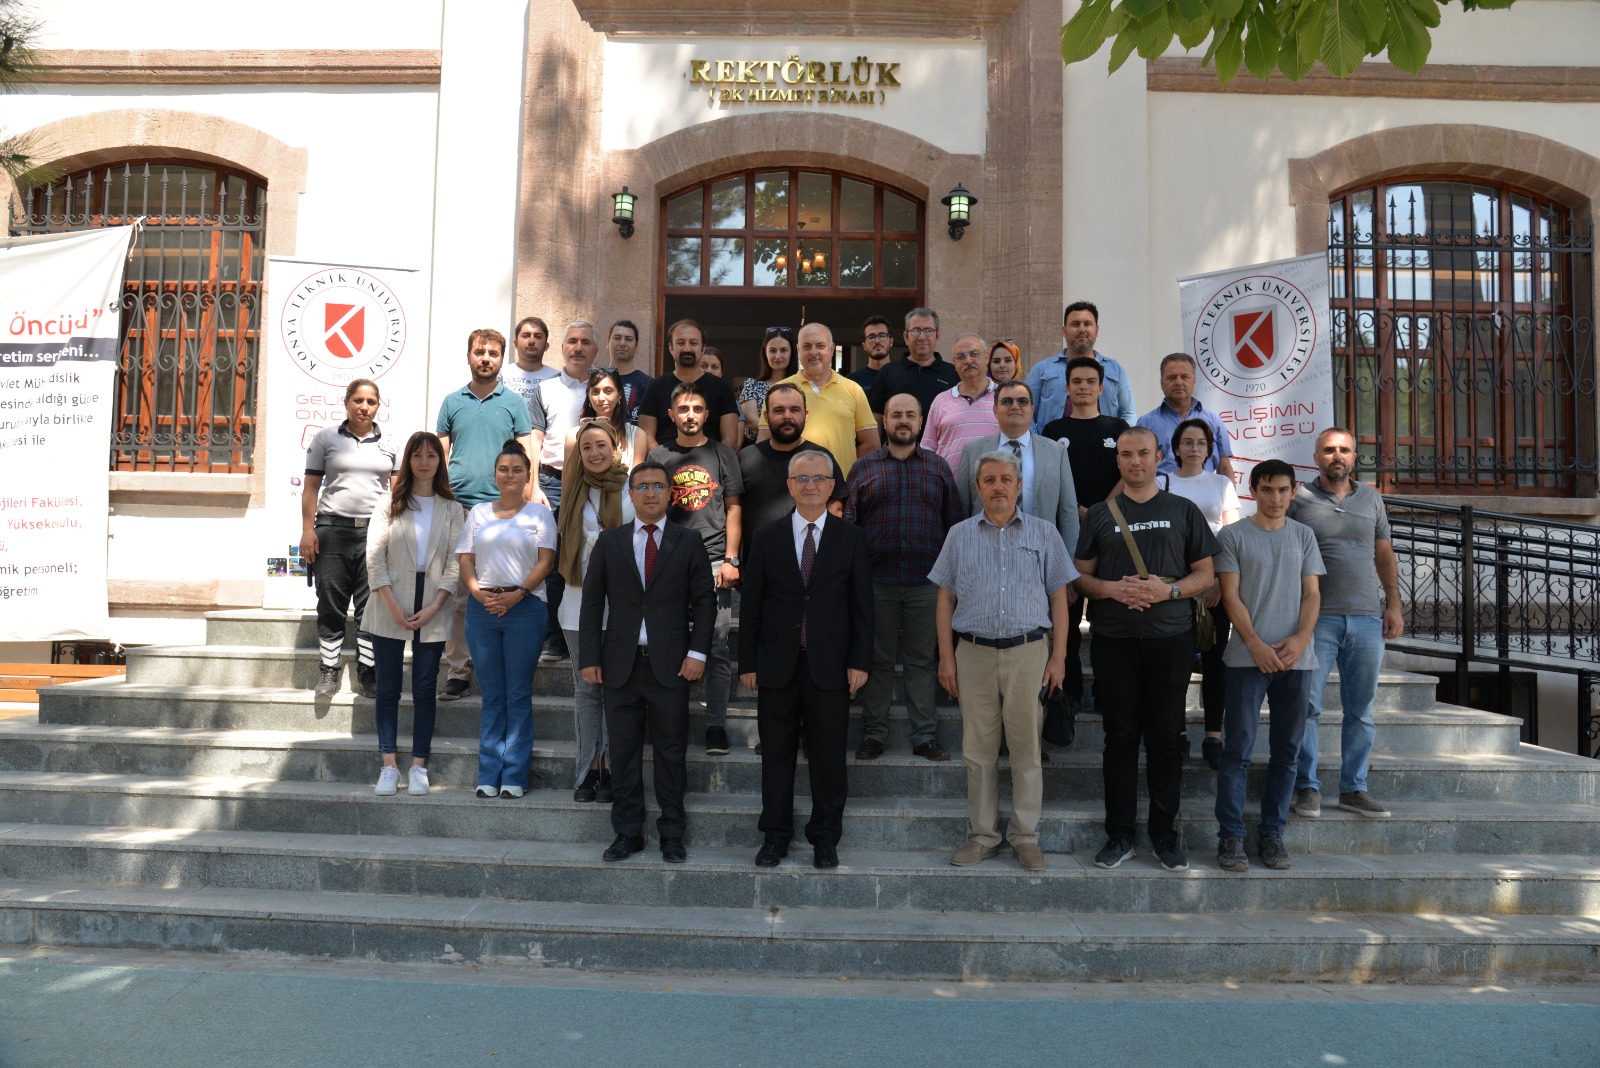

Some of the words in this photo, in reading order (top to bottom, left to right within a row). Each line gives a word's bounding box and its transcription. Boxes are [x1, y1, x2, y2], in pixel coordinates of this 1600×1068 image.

[690, 55, 901, 86] REKTÖRLÜK
[1201, 282, 1253, 327] TEKNİK
[287, 318, 317, 370] KONYA
[1262, 279, 1312, 382] ÜNİVERSİTESİ
[1199, 337, 1230, 386] KONYA
[1245, 382, 1267, 393] 1970
[1219, 400, 1314, 423] ELİŞİMİN
[32, 435, 46, 446] ile
[1227, 421, 1315, 441] NCÜSÜ
